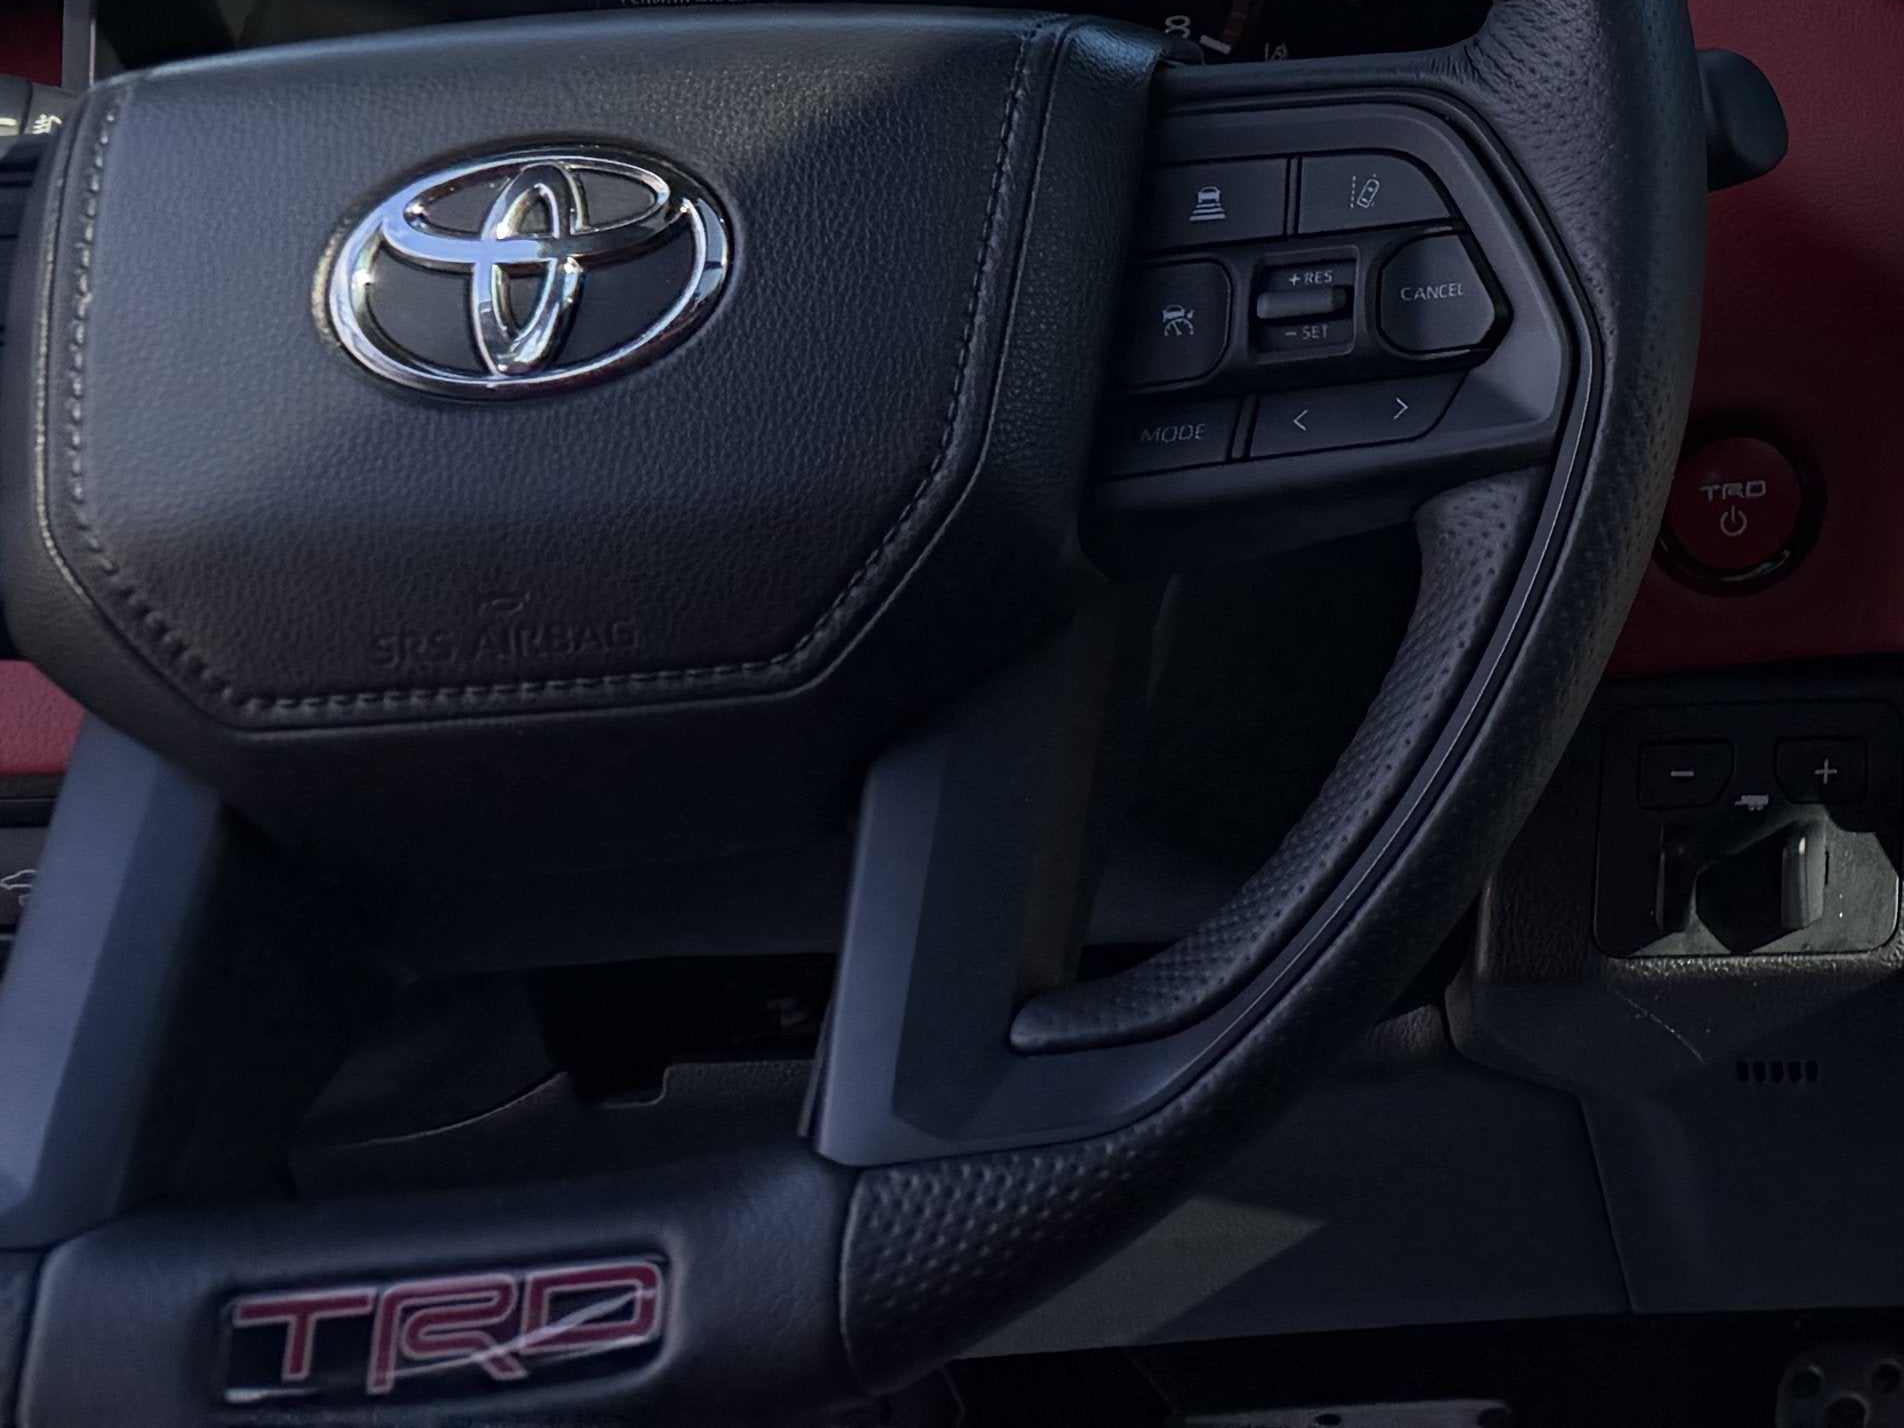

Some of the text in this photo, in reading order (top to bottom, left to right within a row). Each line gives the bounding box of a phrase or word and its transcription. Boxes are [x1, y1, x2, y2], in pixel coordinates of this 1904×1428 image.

[1164, 14, 1192, 39] 8
[1303, 270, 1334, 285] RES
[1400, 284, 1464, 302] CANCEL
[1301, 325, 1329, 341] SET
[1140, 422, 1206, 443] MODE
[1700, 479, 1767, 502] TRD
[232, 1257, 664, 1397] TRD
